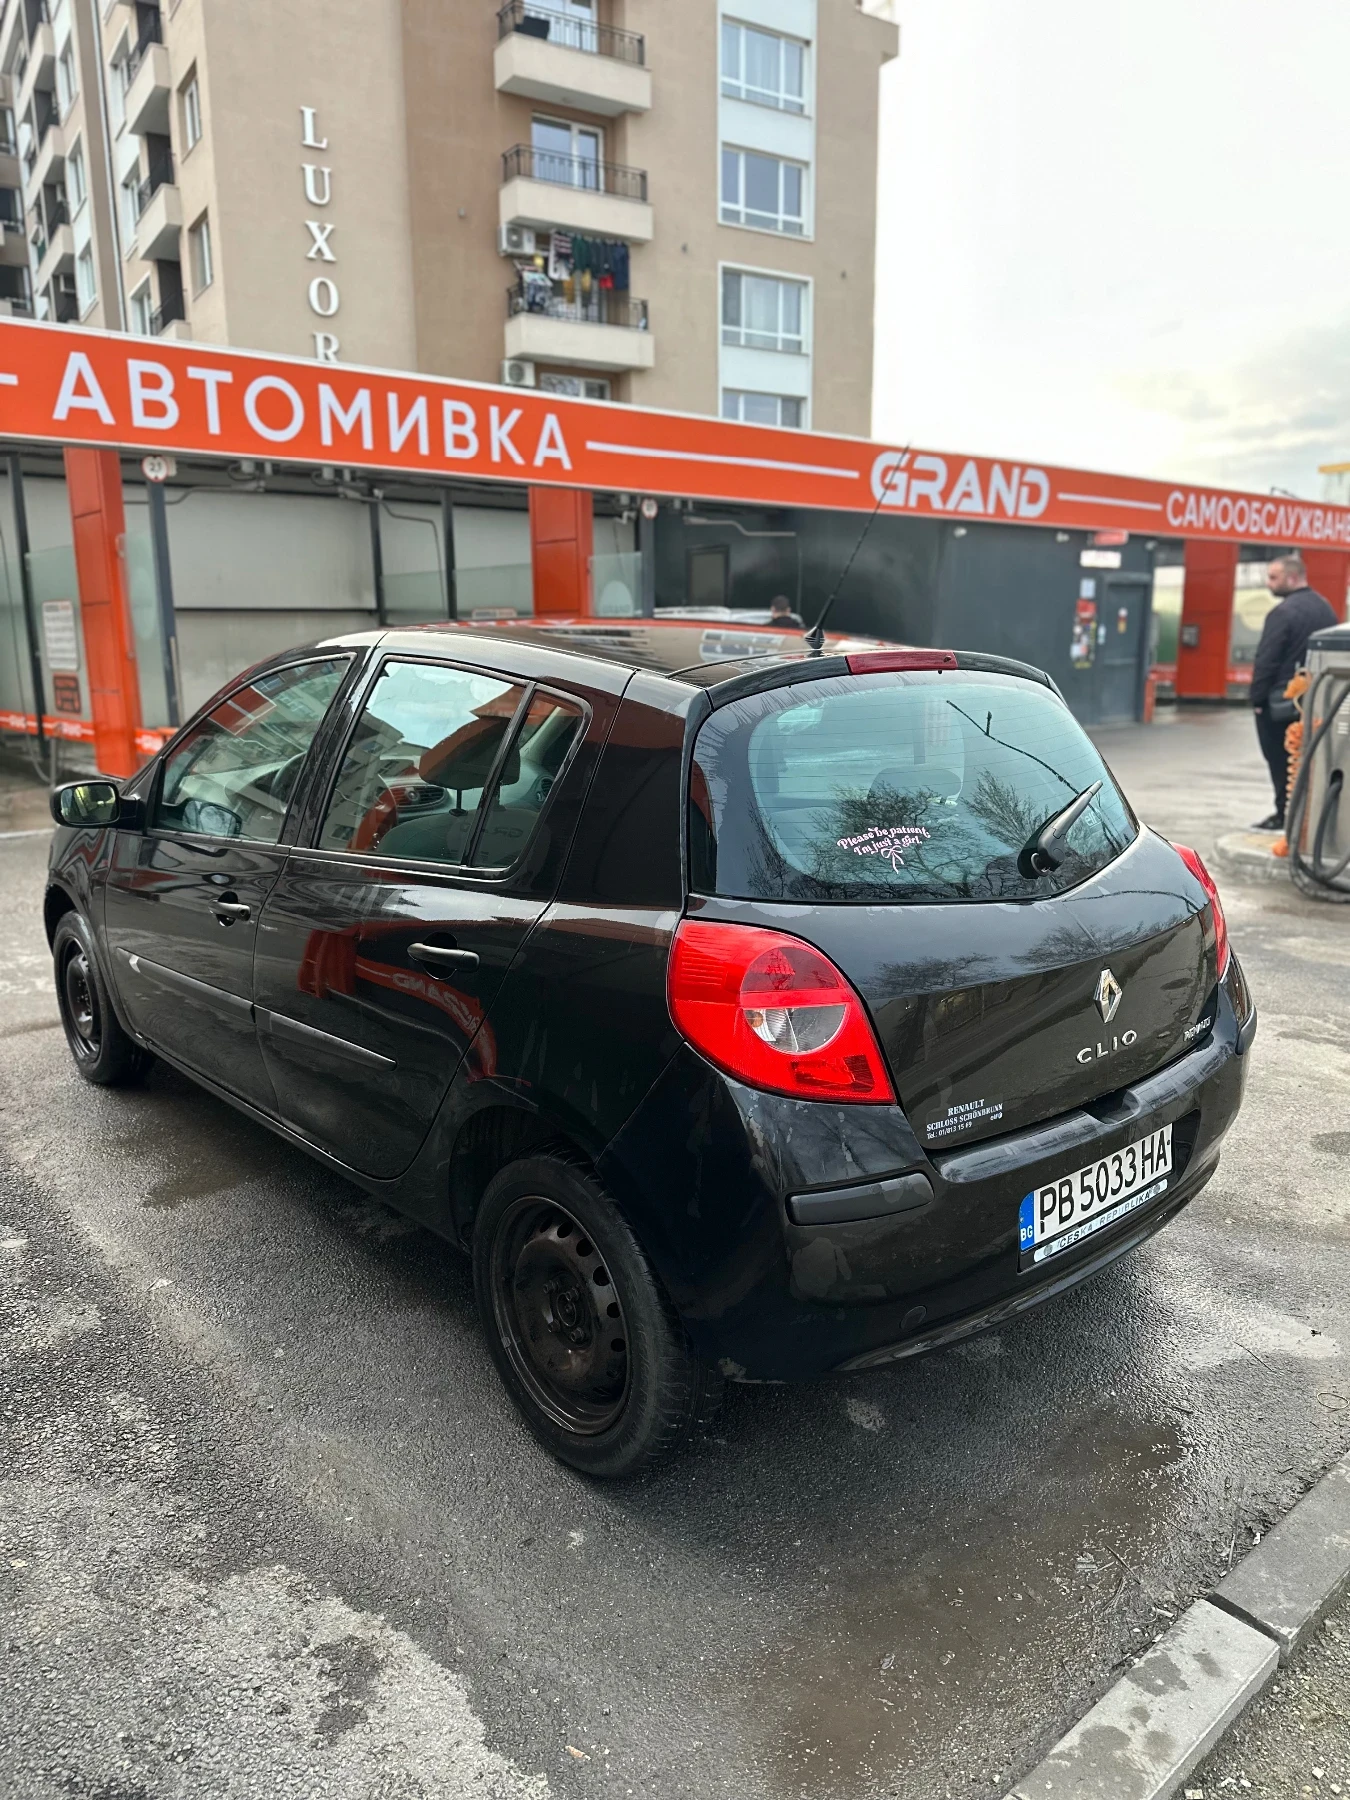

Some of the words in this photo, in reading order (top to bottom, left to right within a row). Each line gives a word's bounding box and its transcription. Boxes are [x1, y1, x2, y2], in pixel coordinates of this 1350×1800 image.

[300, 106, 340, 362] LUXOR
[52, 350, 573, 471] АВТОМИВКА
[870, 450, 1050, 519] GRAND
[837, 831, 874, 850] Please
[868, 826, 888, 838] be
[853, 844, 872, 856] I'm
[871, 837, 892, 855] just
[1076, 1029, 1138, 1064] CLIO
[926, 1116, 958, 1132] SCHLOSS
[947, 1098, 985, 1117] RENAULT
[1039, 1178, 1075, 1235] PB
[1080, 1146, 1138, 1212] 5033
[1141, 1129, 1168, 1181] HA
[1099, 1191, 1151, 1226] REPUBLIKA
[1020, 1224, 1033, 1242] BG
